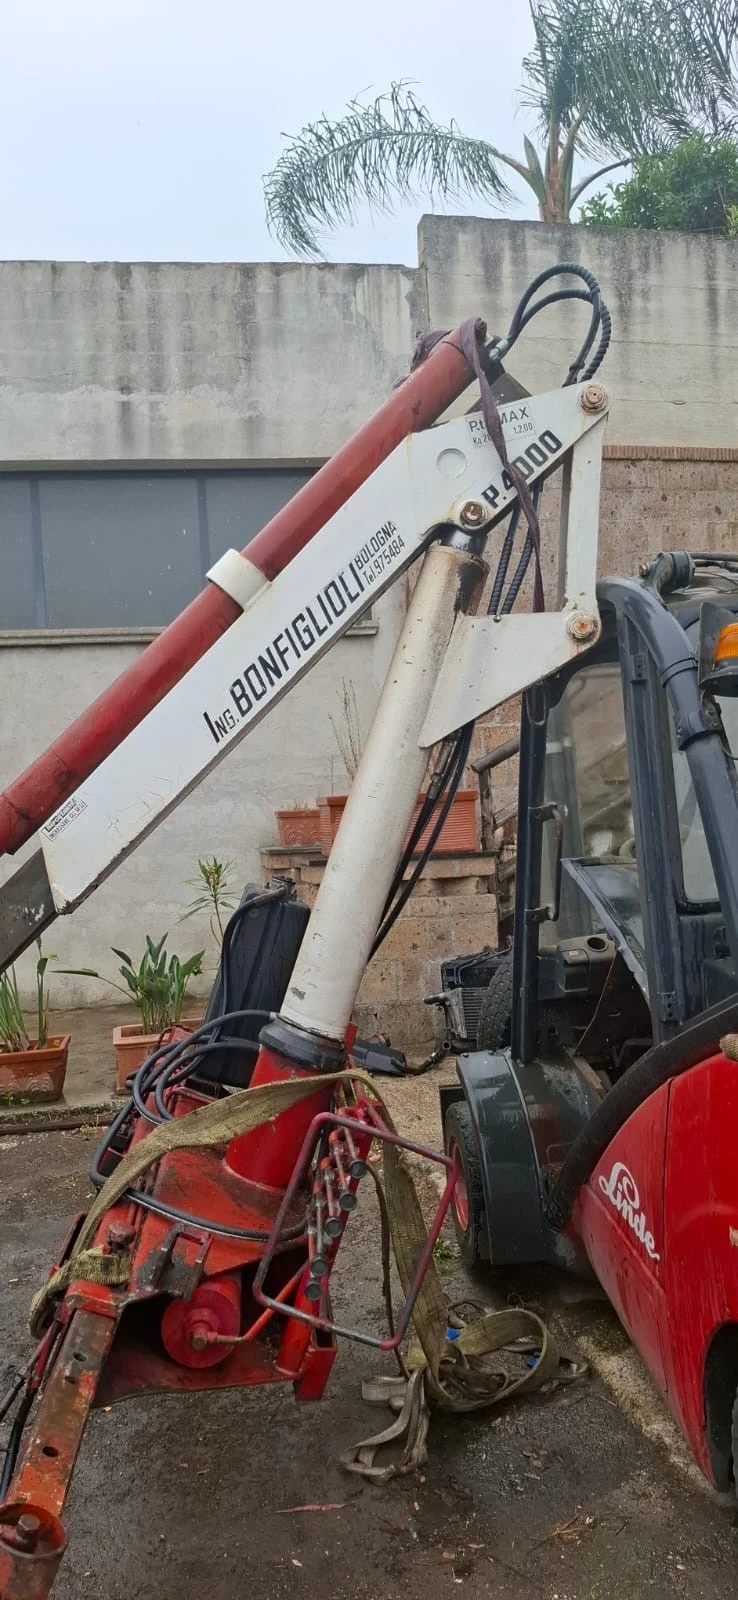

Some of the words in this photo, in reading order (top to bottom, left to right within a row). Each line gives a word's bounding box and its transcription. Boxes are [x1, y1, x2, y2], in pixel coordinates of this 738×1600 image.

[500, 406, 530, 425] MAX
[354, 521, 397, 570] BOLOGNA
[229, 562, 365, 717] BONFIGLIOLI
[599, 1162, 660, 1261] Linde
